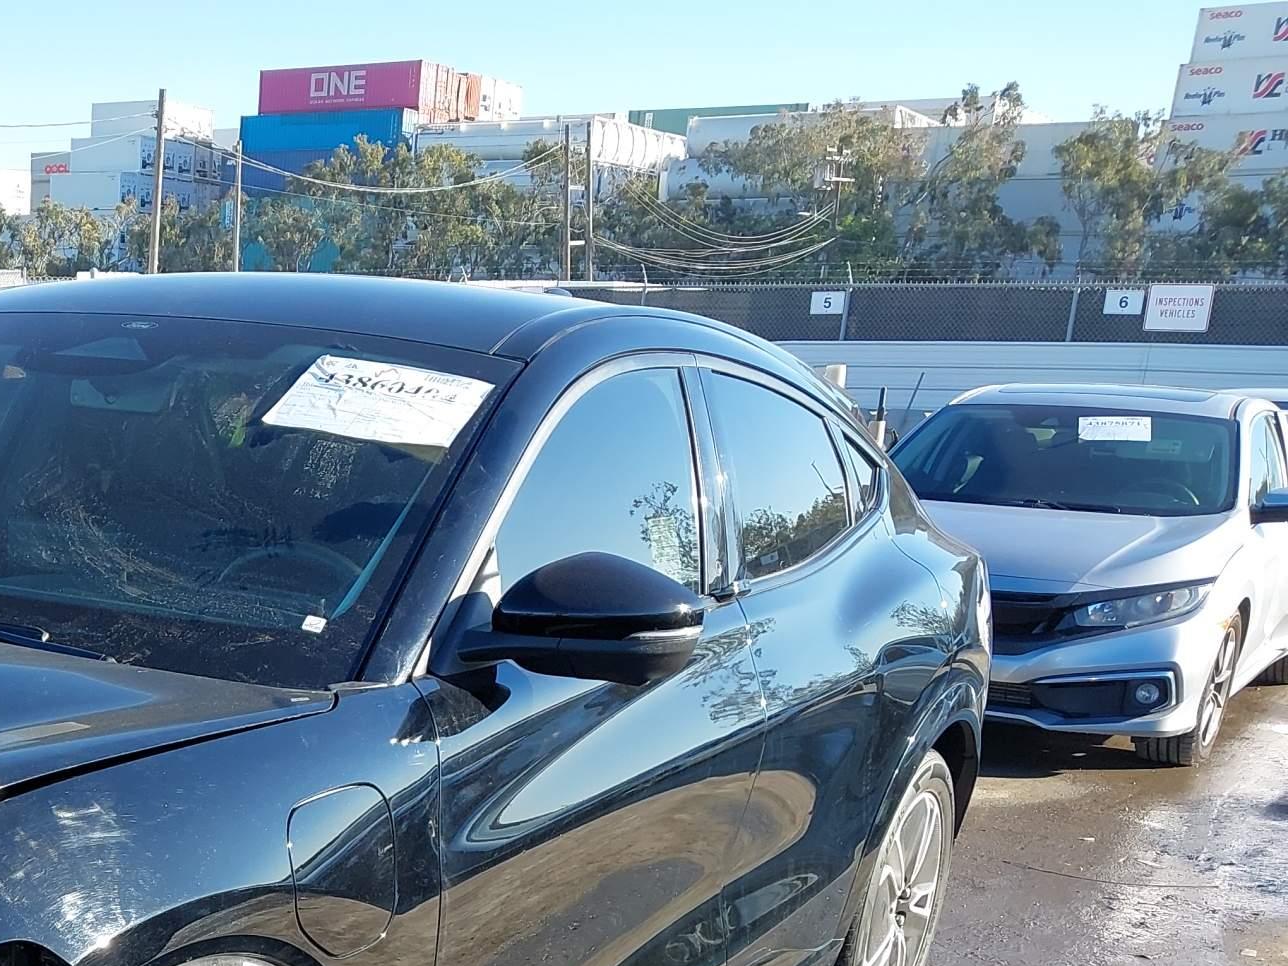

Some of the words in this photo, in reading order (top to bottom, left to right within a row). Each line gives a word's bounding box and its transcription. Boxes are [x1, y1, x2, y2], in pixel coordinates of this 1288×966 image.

[1209, 10, 1243, 20] seaco
[1189, 66, 1223, 76] seaco
[310, 70, 367, 97] ONE
[1170, 121, 1204, 132] seaco
[45, 163, 70, 174] OOCL
[823, 297, 832, 309] 5
[1119, 295, 1129, 309] 6
[1155, 297, 1205, 307] INSPECTIONS
[1159, 309, 1196, 319] VEHICLES
